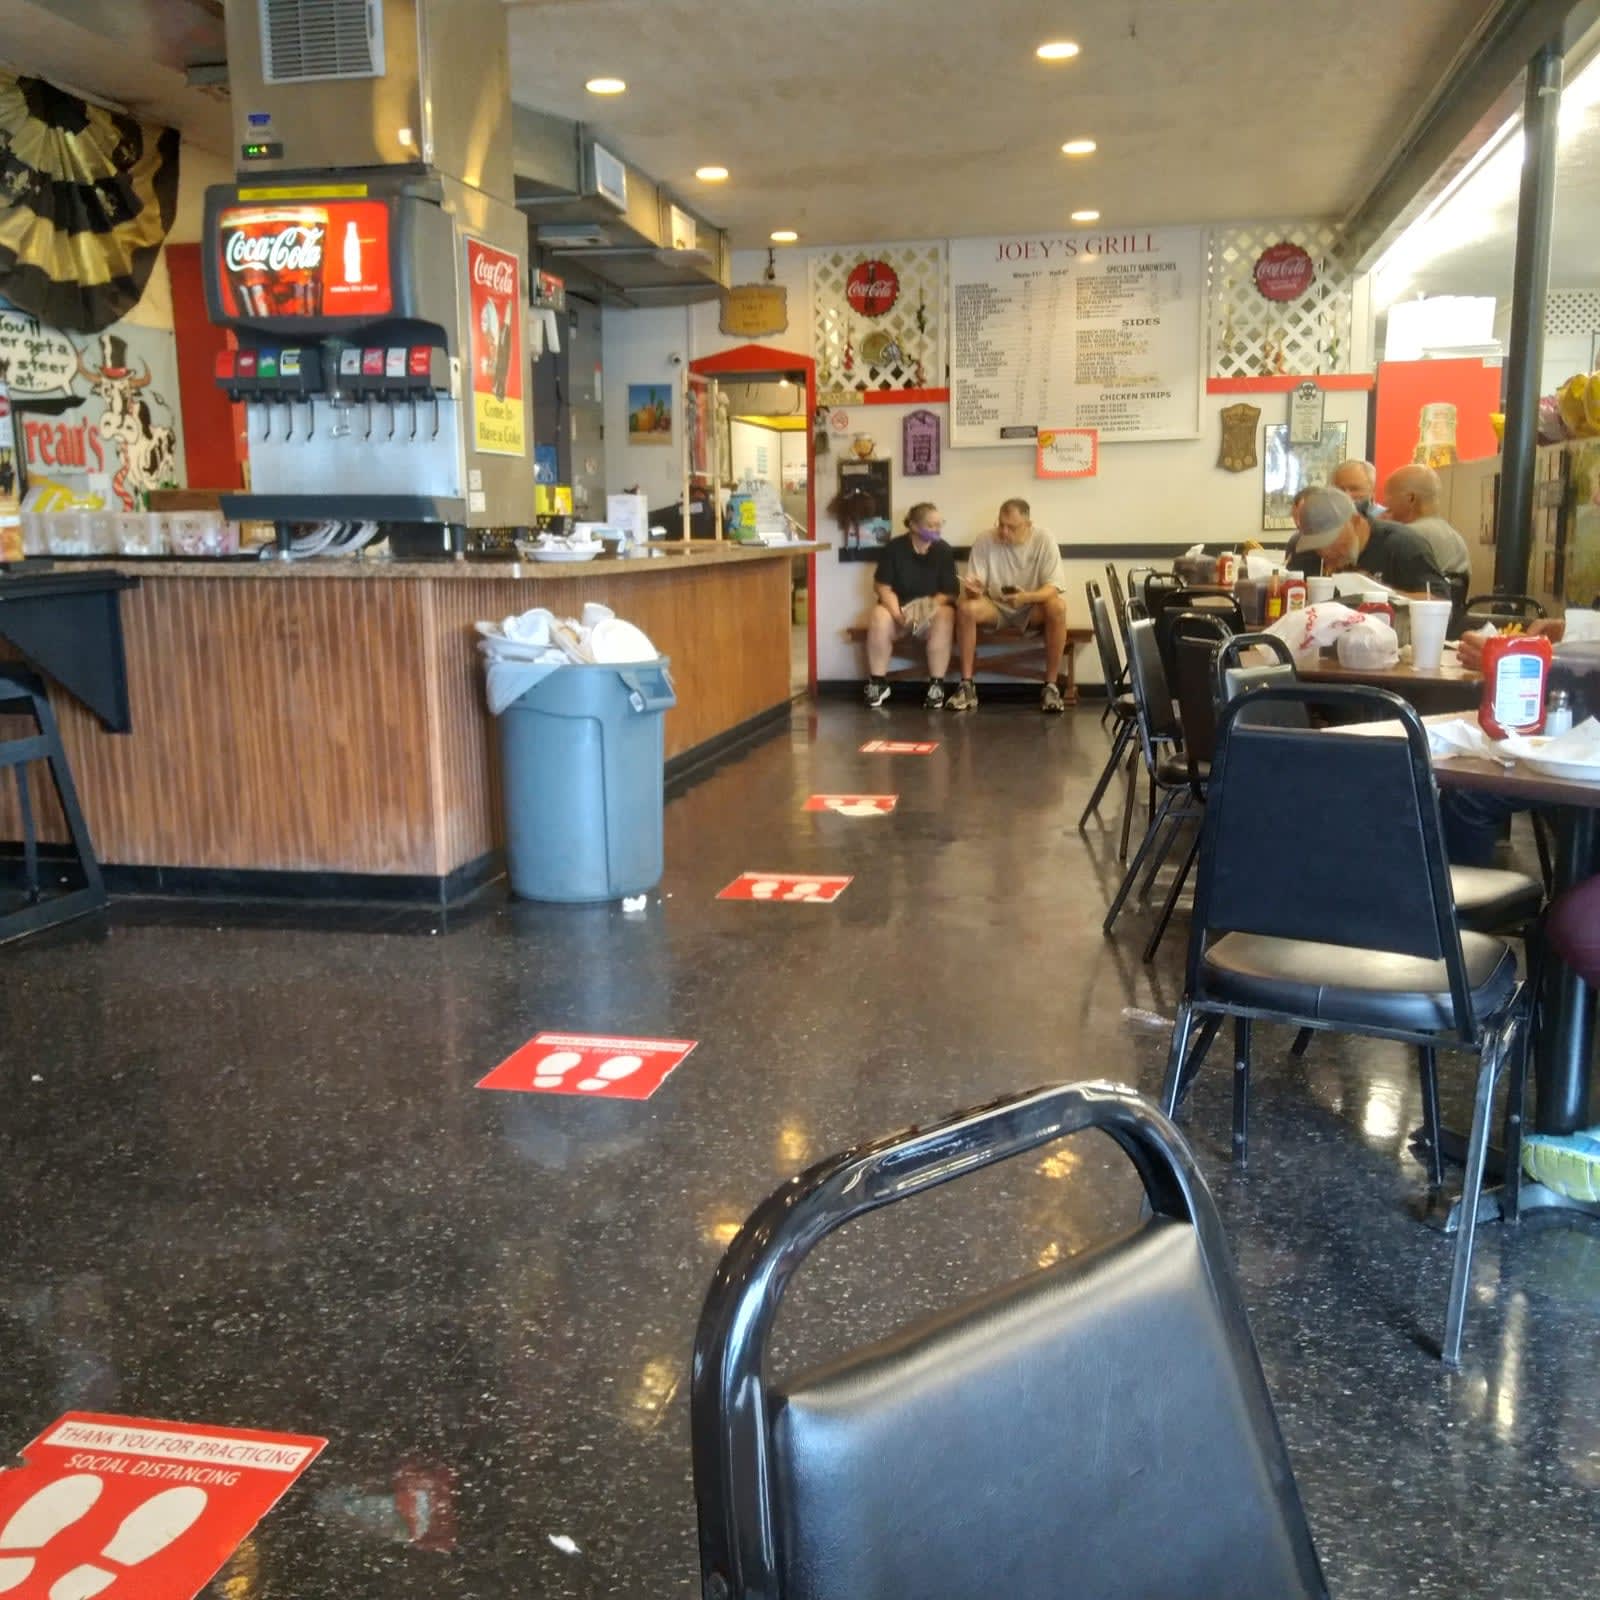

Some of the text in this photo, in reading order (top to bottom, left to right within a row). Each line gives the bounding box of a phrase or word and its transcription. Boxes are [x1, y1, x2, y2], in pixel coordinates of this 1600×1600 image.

[226, 225, 325, 272] Coca-Cola
[995, 232, 1161, 263] JOEY'S GRILL
[474, 252, 514, 294] Coca-Cola
[1106, 263, 1137, 274] SPECIALTY
[847, 279, 894, 298] Coca-Cola
[1121, 317, 1161, 327] SIDES
[17, 357, 69, 375] steer
[1099, 391, 1171, 401] CHICKEN STRIPS
[59, 1426, 301, 1467] THANK YOU FOR PRACTICING
[64, 1453, 242, 1487] SOCIAL DISTANCING
